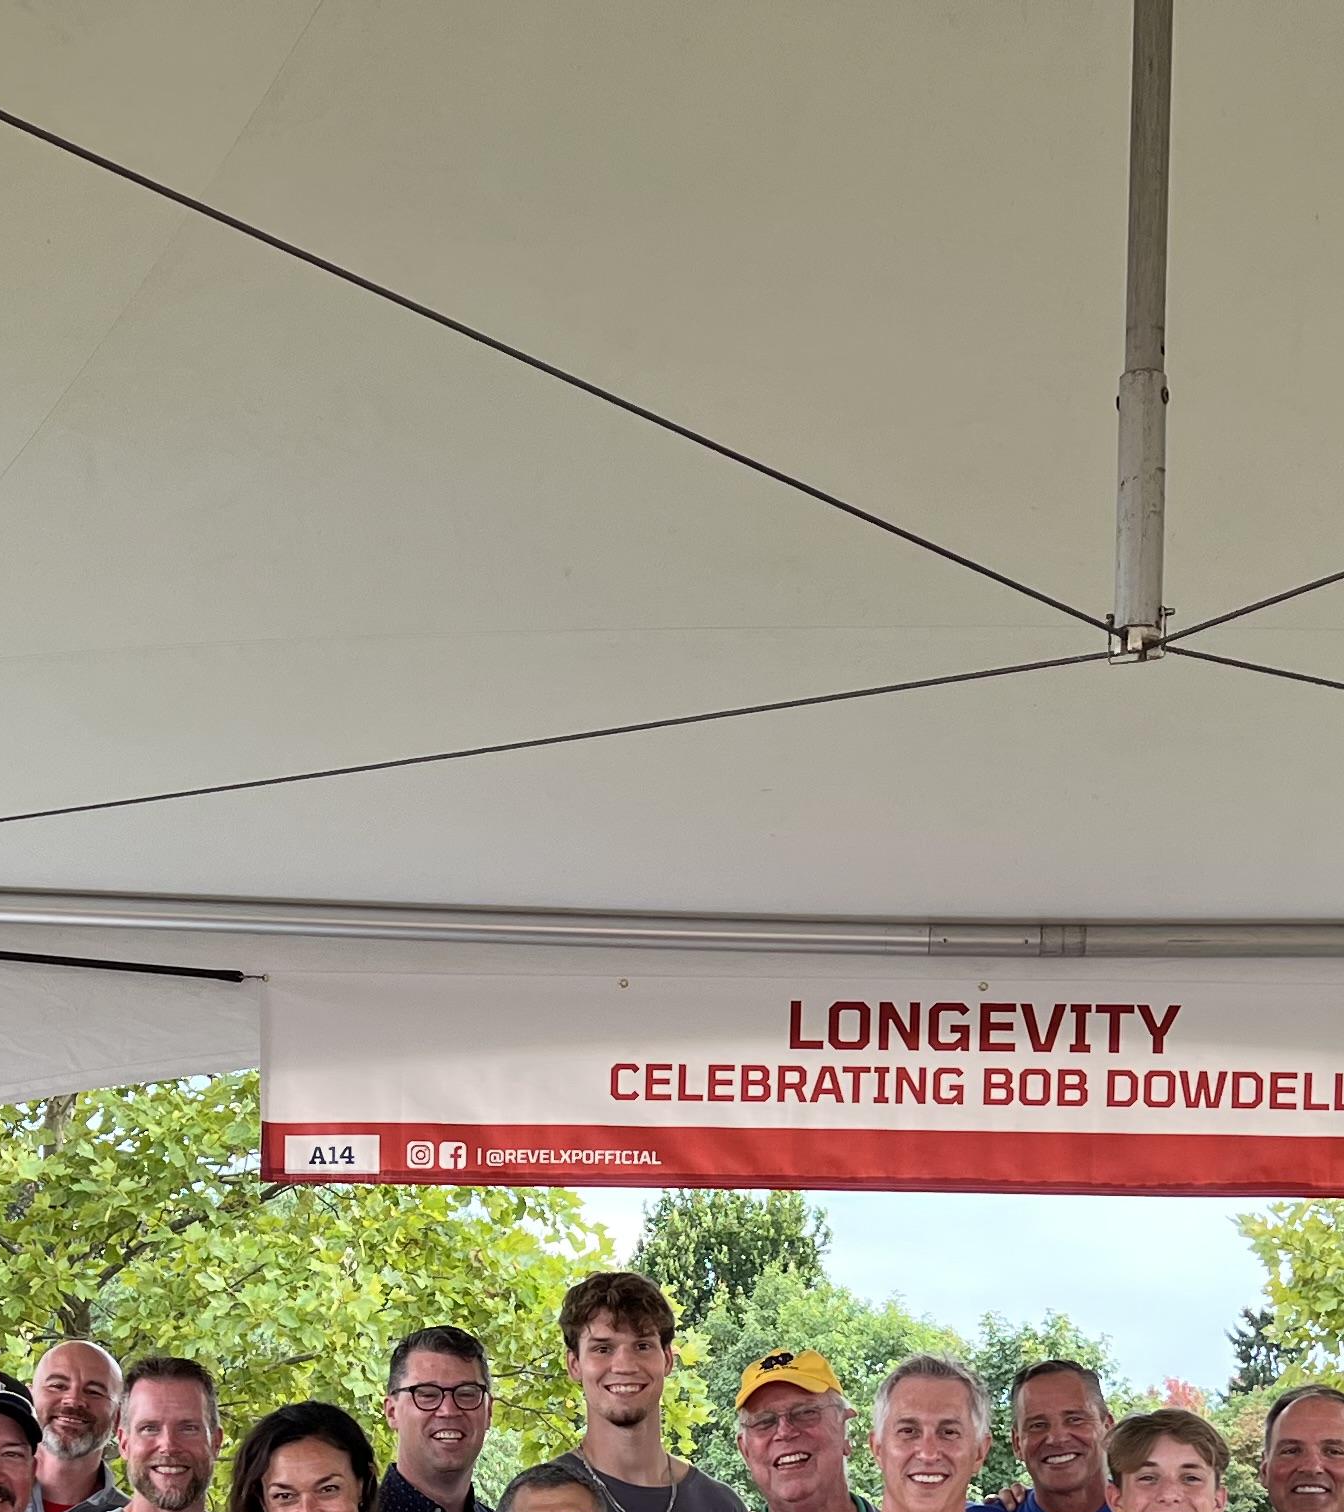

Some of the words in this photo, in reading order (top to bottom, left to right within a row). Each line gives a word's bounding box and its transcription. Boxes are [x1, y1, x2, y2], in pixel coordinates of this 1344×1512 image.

[789, 1000, 1182, 1054] LONGEVITY
[610, 1063, 964, 1105] CELEBRATING
[982, 1068, 1088, 1107] BOB
[308, 1145, 355, 1165] A14
[485, 1148, 661, 1168] @REVELXPOFFICIAL
